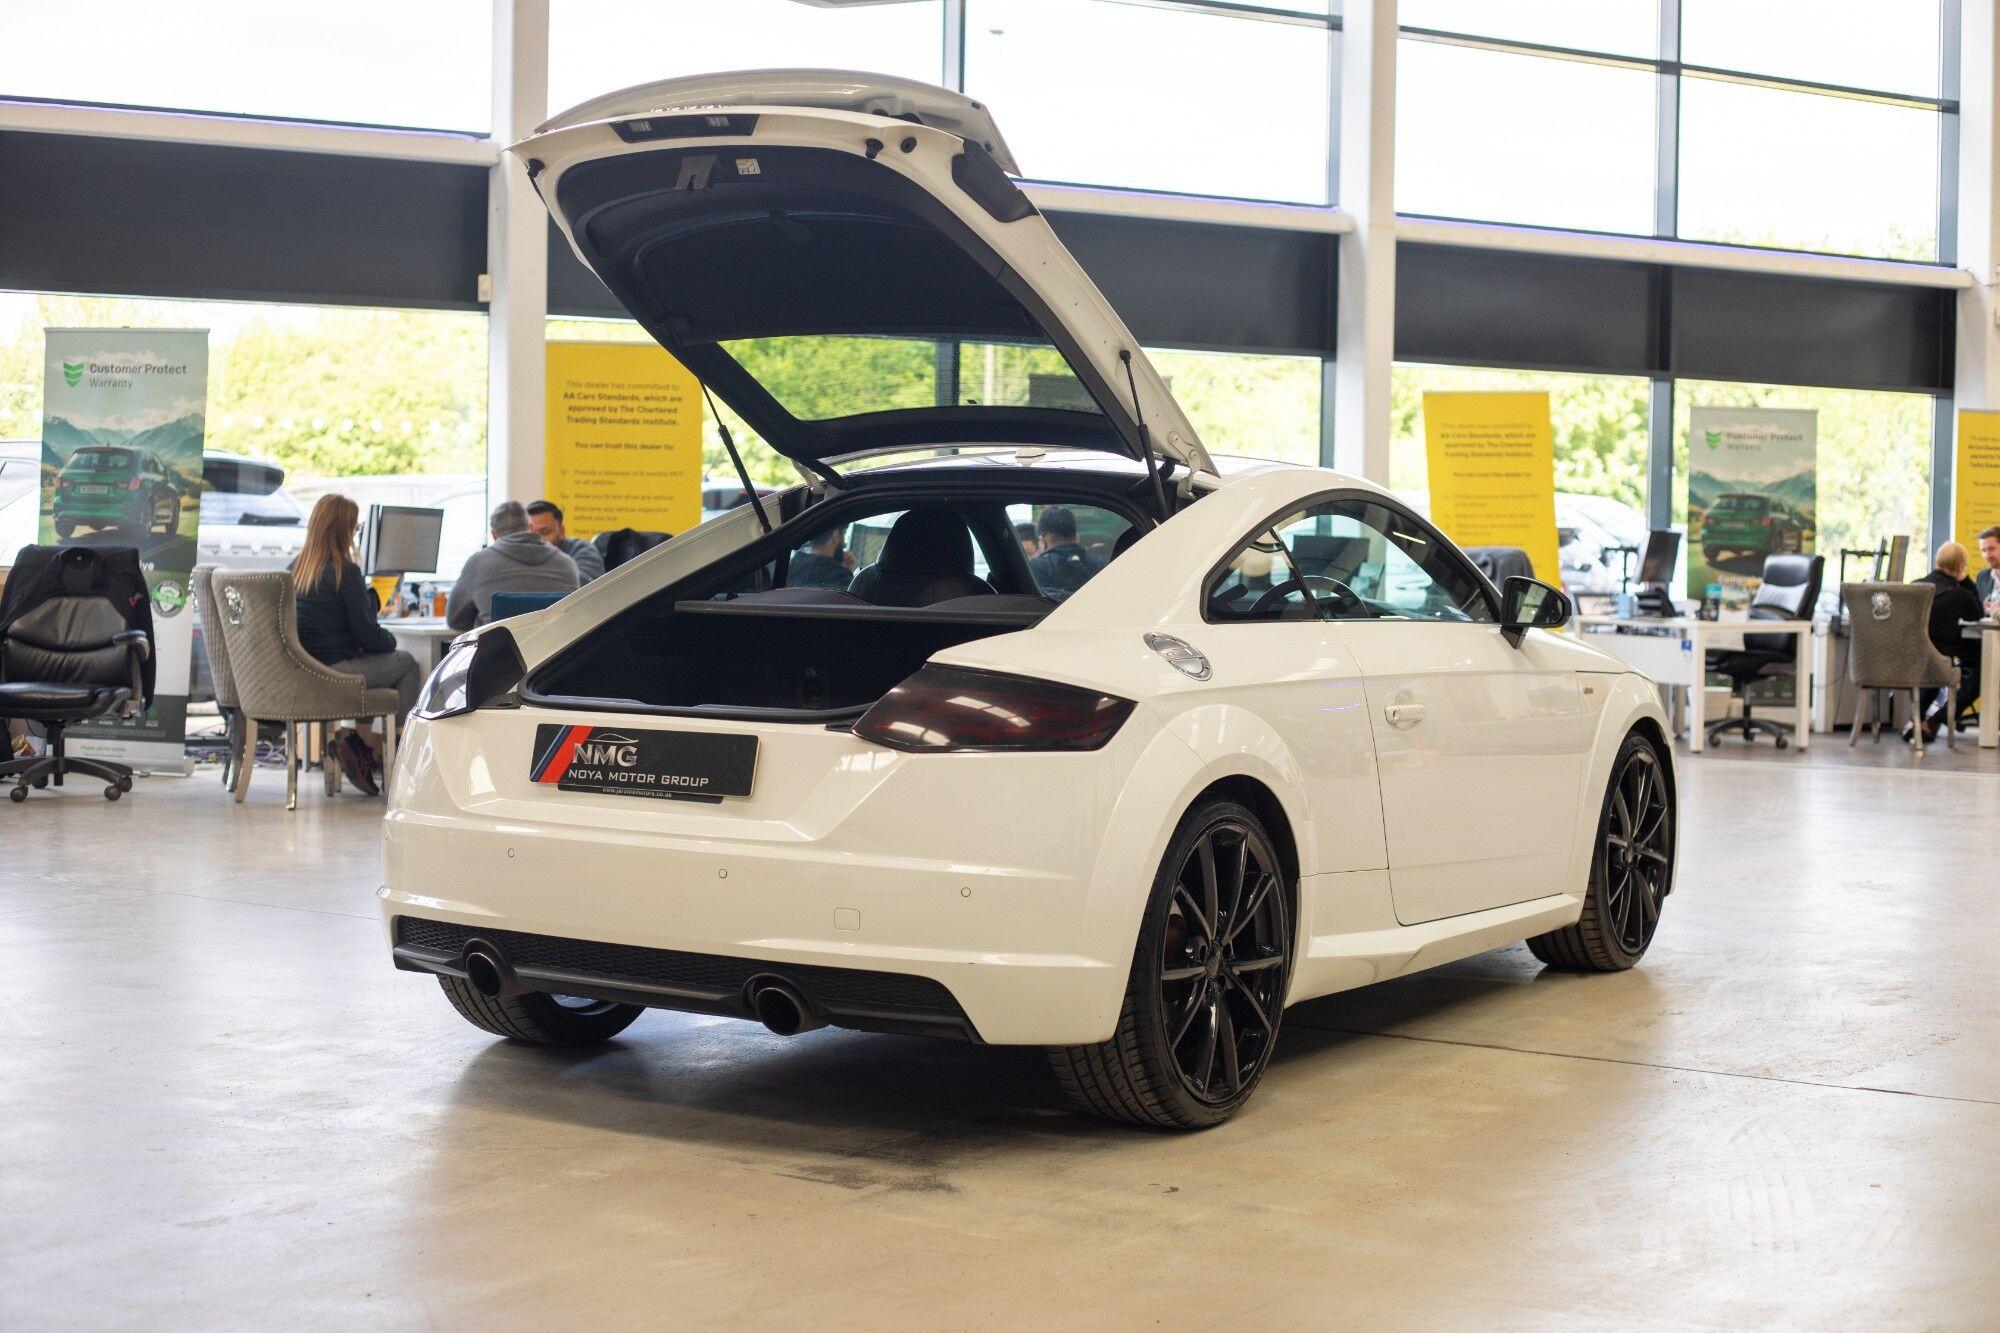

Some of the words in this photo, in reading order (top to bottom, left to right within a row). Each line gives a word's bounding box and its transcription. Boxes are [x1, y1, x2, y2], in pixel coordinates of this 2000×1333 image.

[89, 363, 142, 375] Customer
[144, 363, 187, 375] Protect
[89, 378, 134, 389] Warranty
[584, 381, 609, 390] dealer
[627, 382, 669, 391] committed
[563, 392, 575, 400] AA
[577, 392, 595, 401] Cars
[643, 394, 668, 402] which
[568, 404, 606, 414] approved
[608, 405, 618, 415] by
[620, 405, 635, 413] The
[636, 406, 678, 415] Chartered
[566, 415, 597, 426] Trading
[599, 416, 640, 426] Standards
[575, 441, 588, 450] You
[590, 442, 603, 450] can
[604, 442, 622, 450] trust
[639, 443, 662, 451] dealer
[572, 742, 639, 767] NMG
[568, 769, 603, 780] NOYA
[608, 771, 656, 784] MOTOR
[661, 775, 709, 787] GROUP
